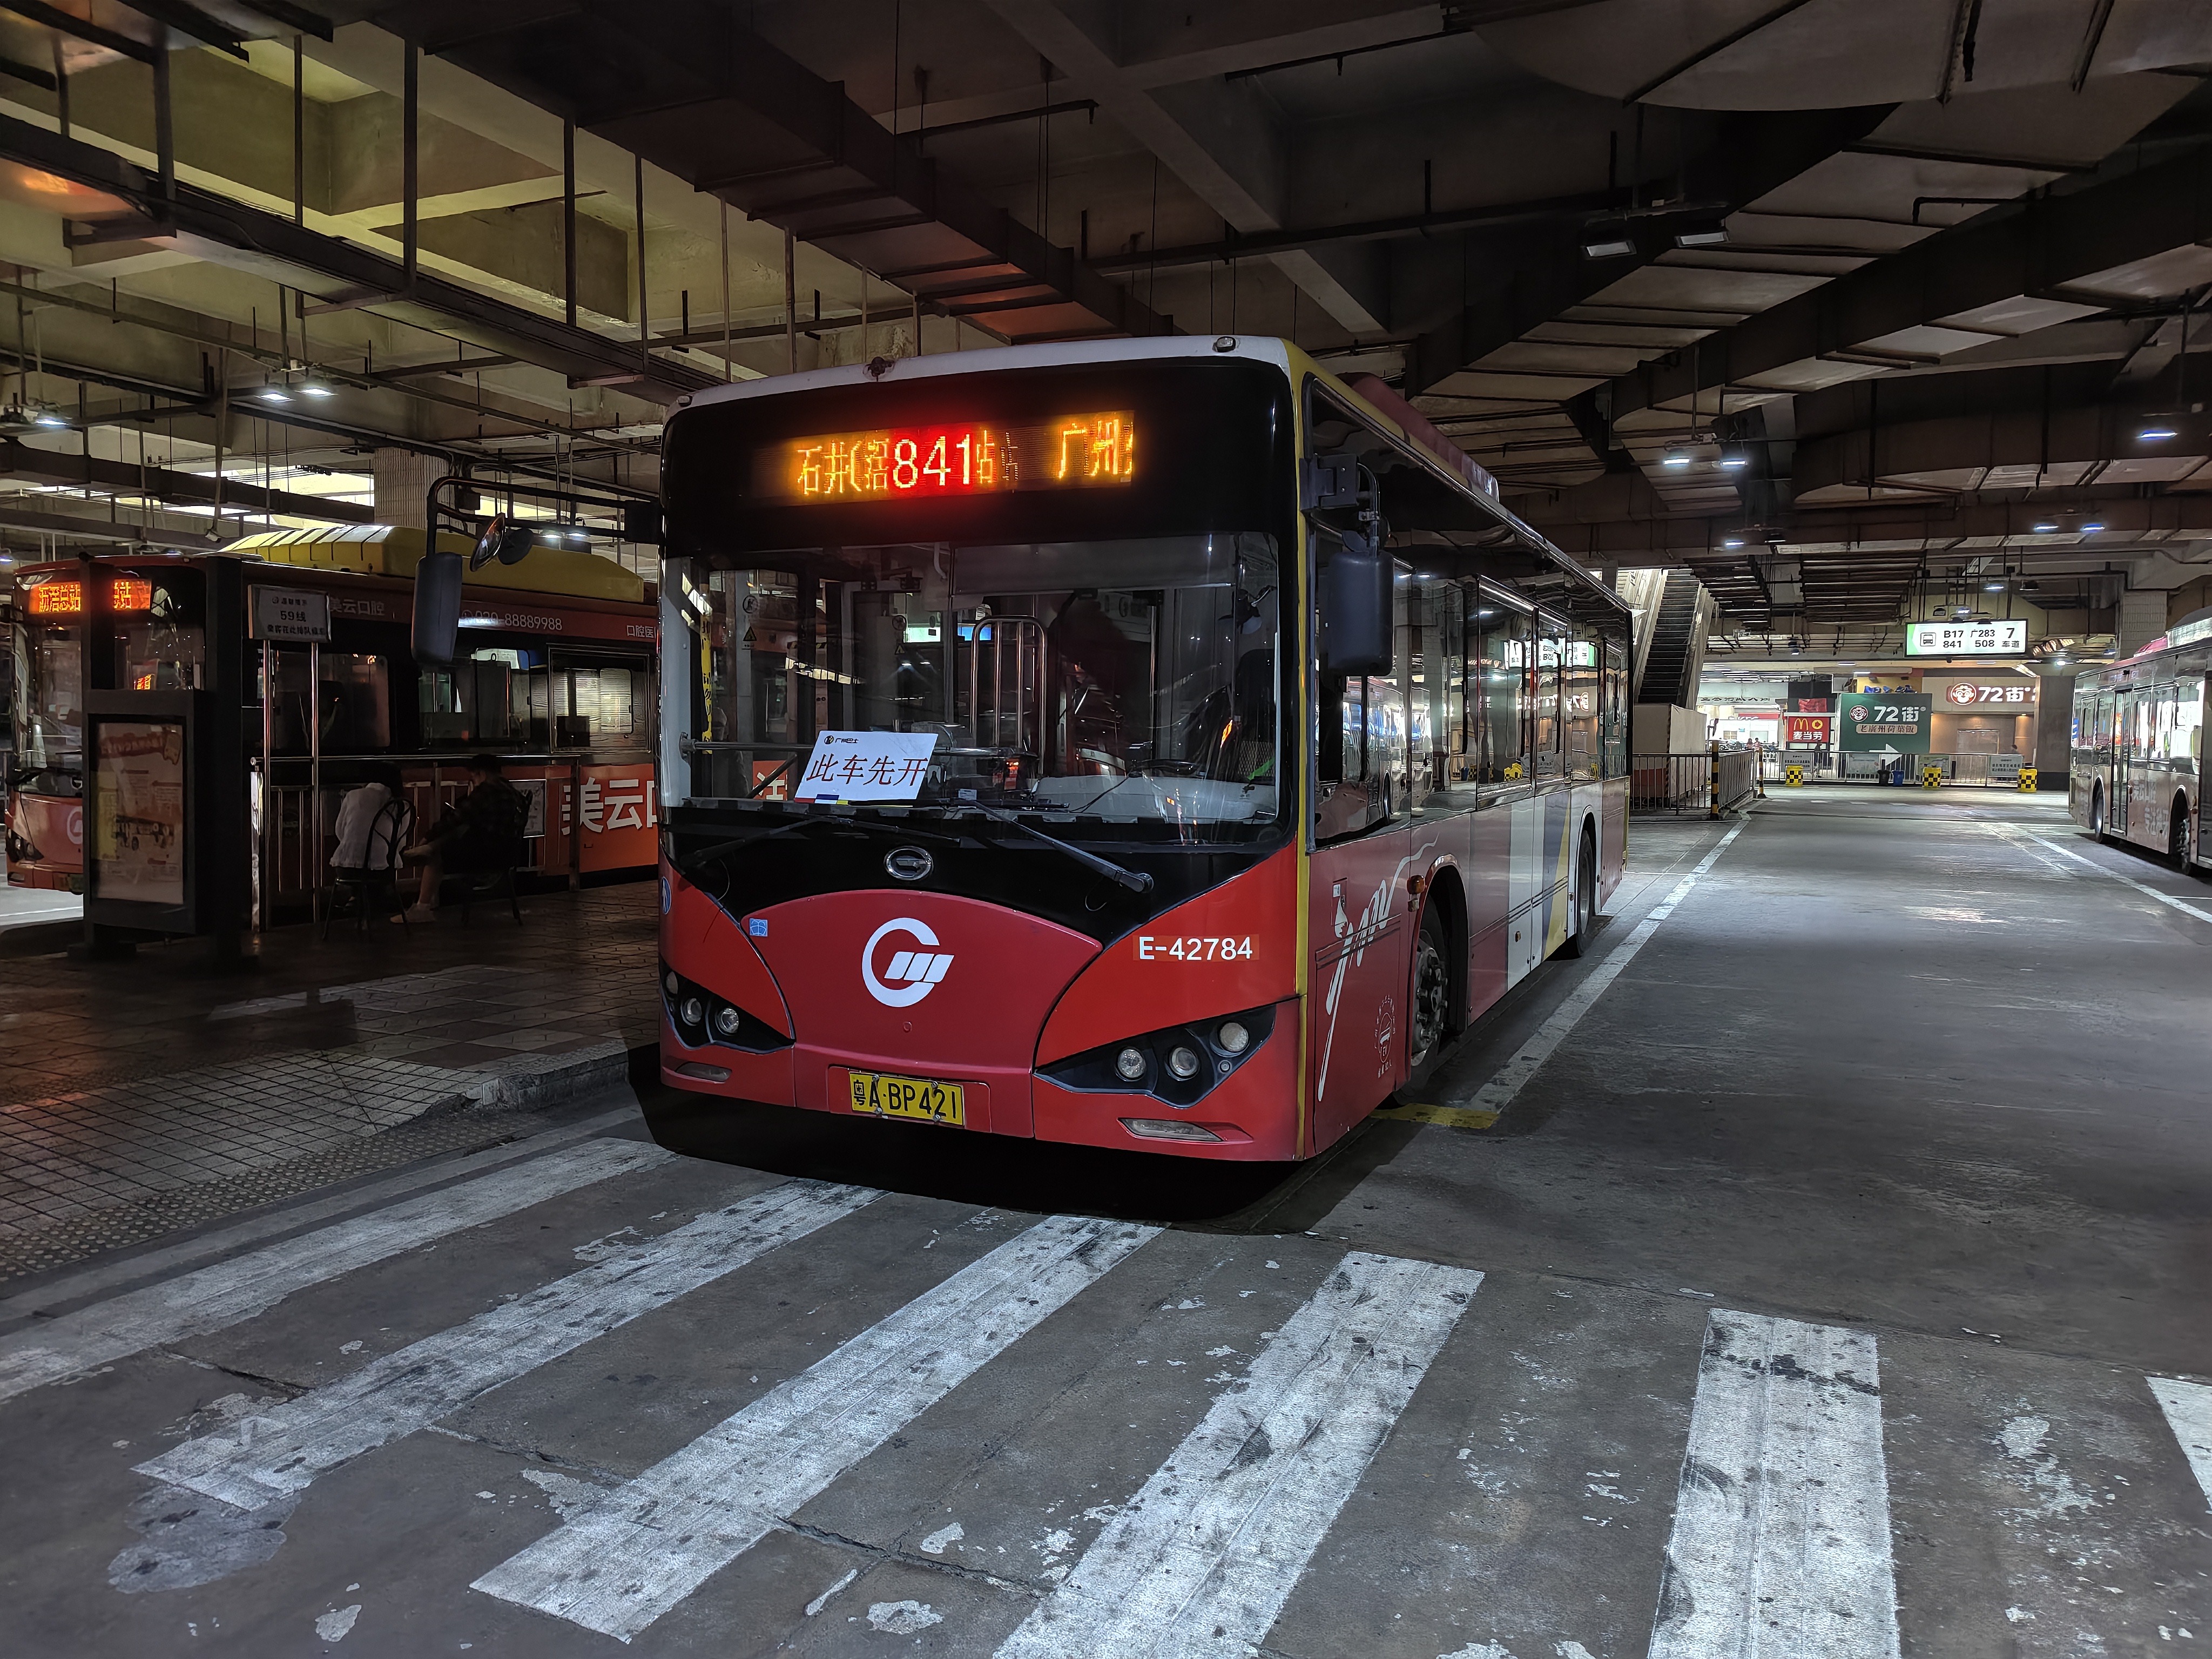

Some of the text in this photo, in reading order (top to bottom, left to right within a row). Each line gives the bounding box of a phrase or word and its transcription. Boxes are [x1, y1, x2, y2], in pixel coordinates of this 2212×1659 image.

[892, 434, 971, 489] 841
[280, 610, 307, 622] 59线
[626, 625, 656, 638] 口腔医
[1970, 629, 1995, 637] 广283
[2006, 628, 2015, 638] 7
[1874, 706, 1919, 721] 72街
[806, 753, 928, 786] 此车先开
[1139, 936, 1253, 960] E-42784
